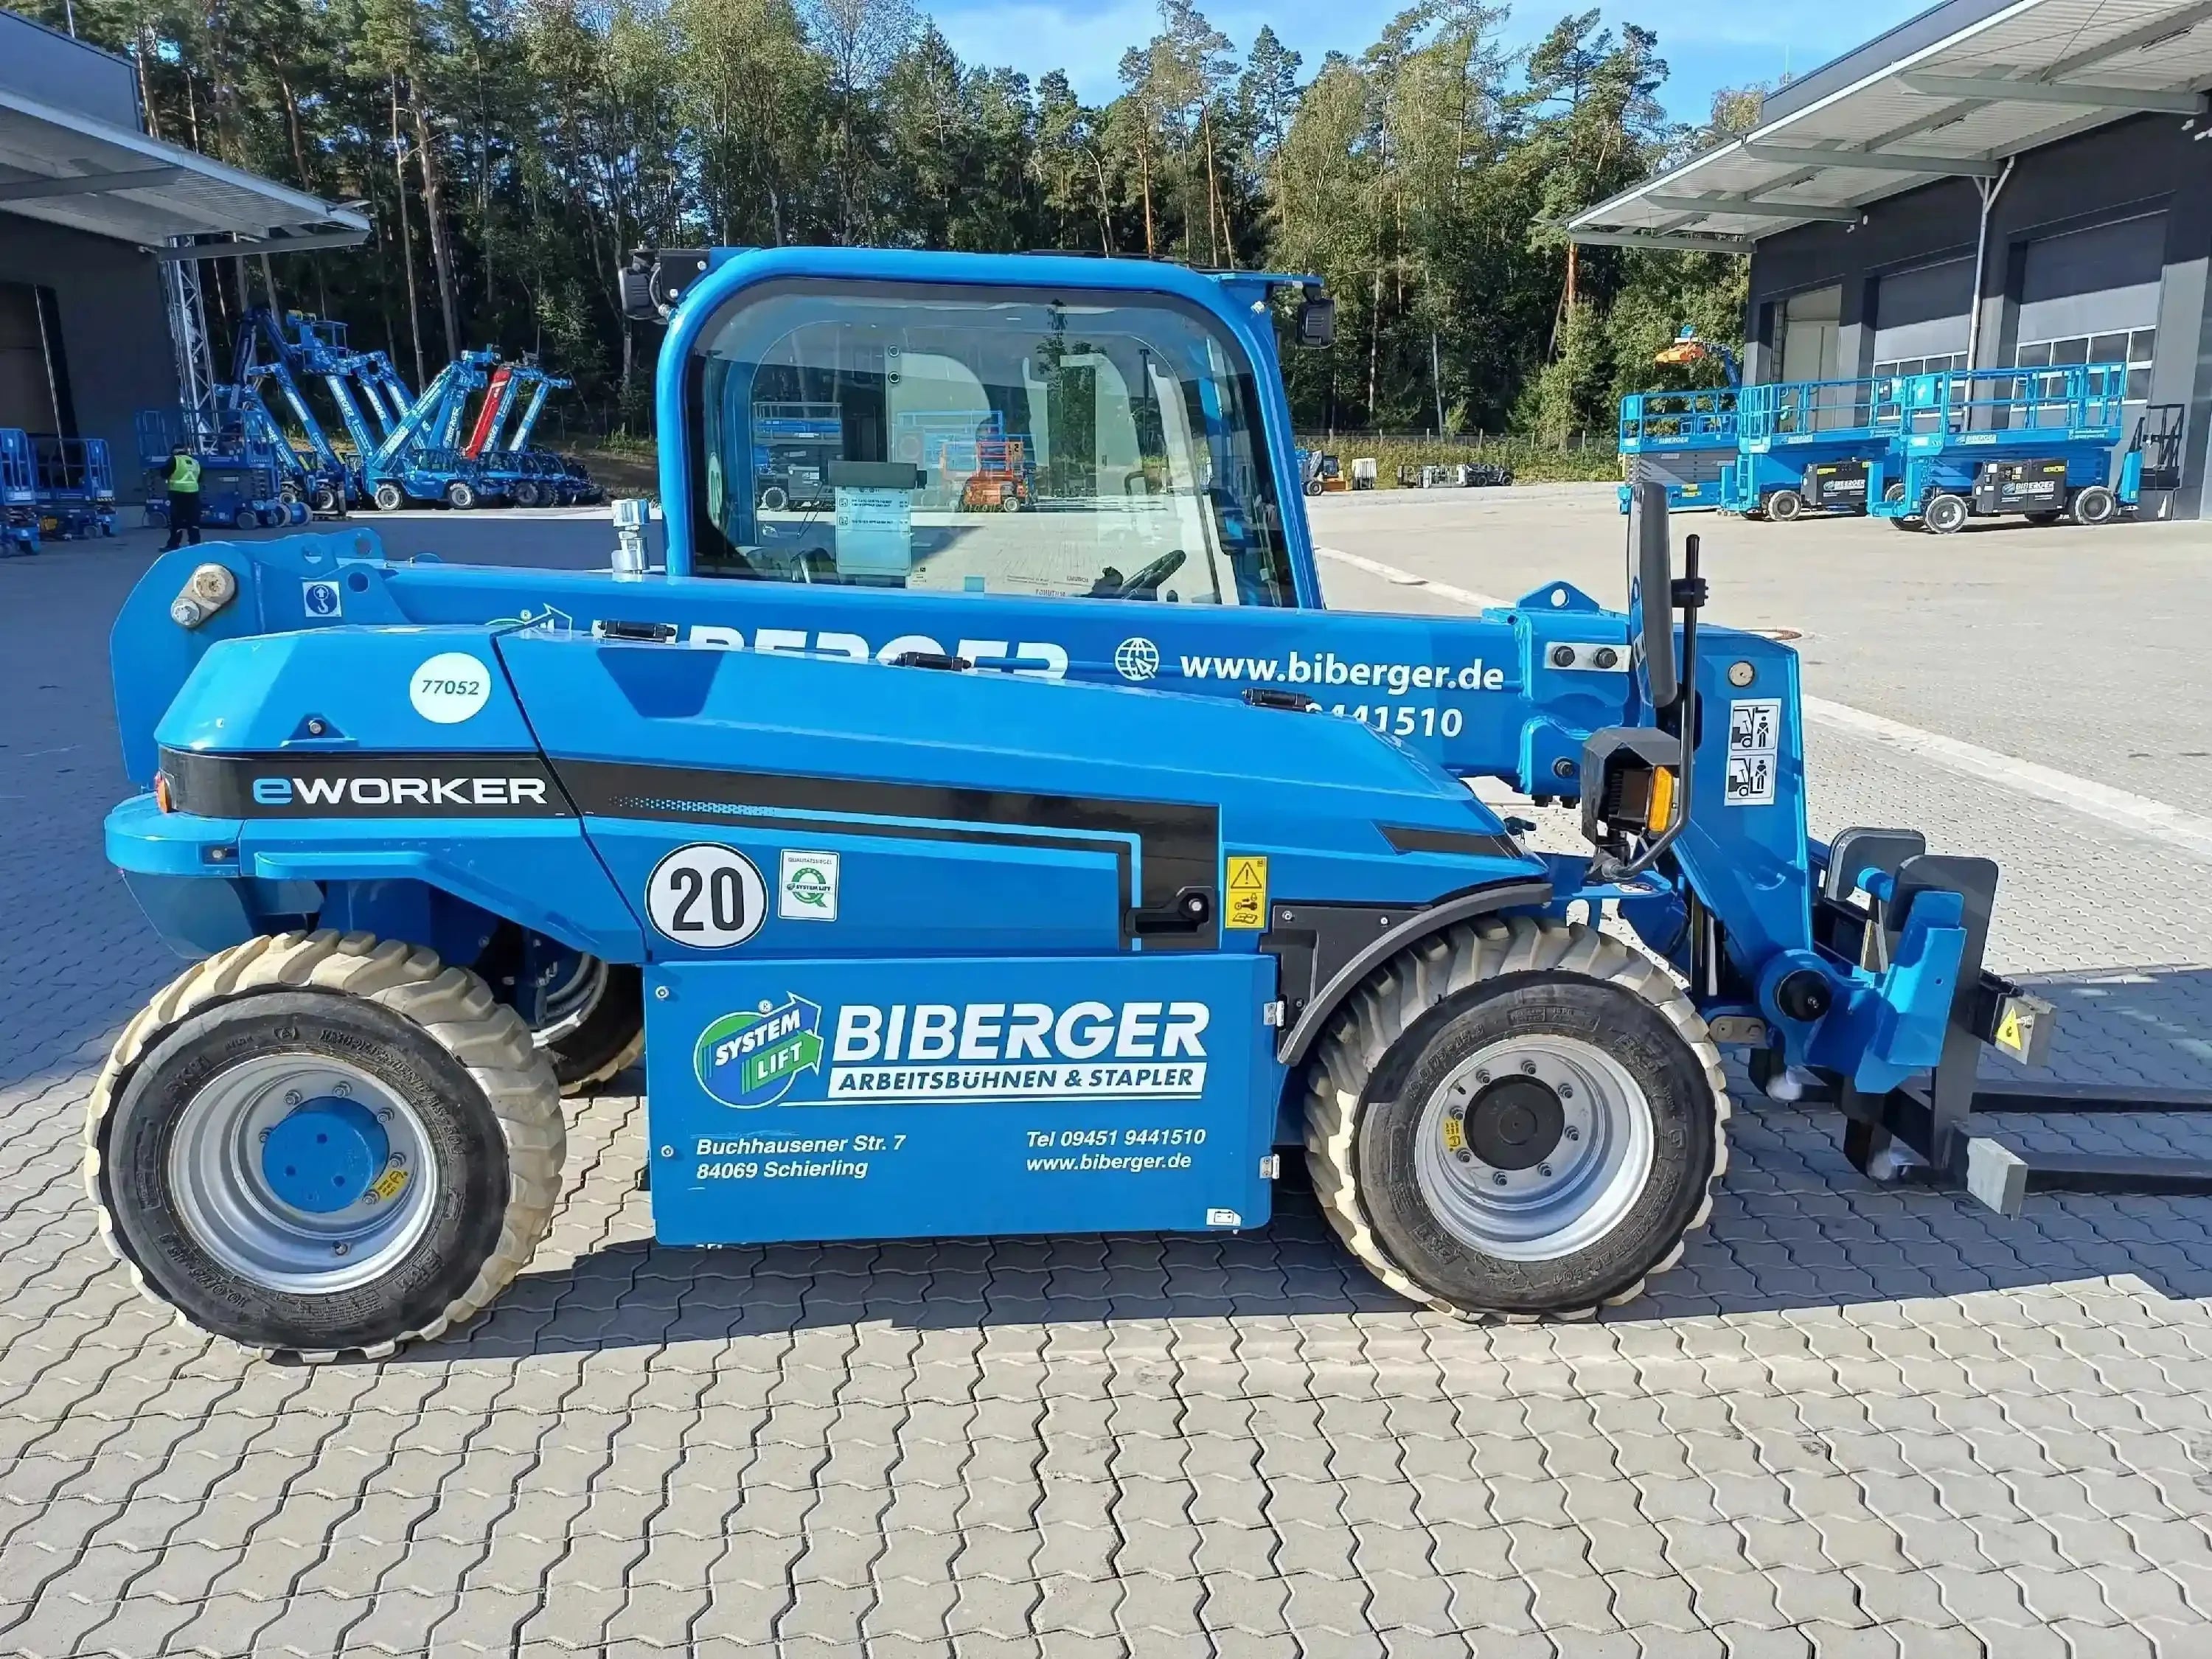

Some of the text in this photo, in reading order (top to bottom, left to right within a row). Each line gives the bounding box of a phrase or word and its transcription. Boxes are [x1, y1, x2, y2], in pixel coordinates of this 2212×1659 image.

[1180, 651, 1504, 695] www.biberger.de
[422, 679, 480, 696] 77052
[252, 778, 549, 805] eWORKER
[670, 866, 745, 931] 20
[714, 1008, 801, 1067] SYSTEM
[832, 1001, 1211, 1062] BIBERGER
[757, 1040, 804, 1080] LIFT
[838, 1068, 1194, 1091] ARBEITSBÜHNEN & STAPLER
[696, 1134, 907, 1155] Buchhausener Str. 7
[1026, 1128, 1207, 1148] Tel 09451 9441510
[696, 1159, 869, 1180] 84069 Schierling
[1026, 1152, 1192, 1173] www.biberger.de
